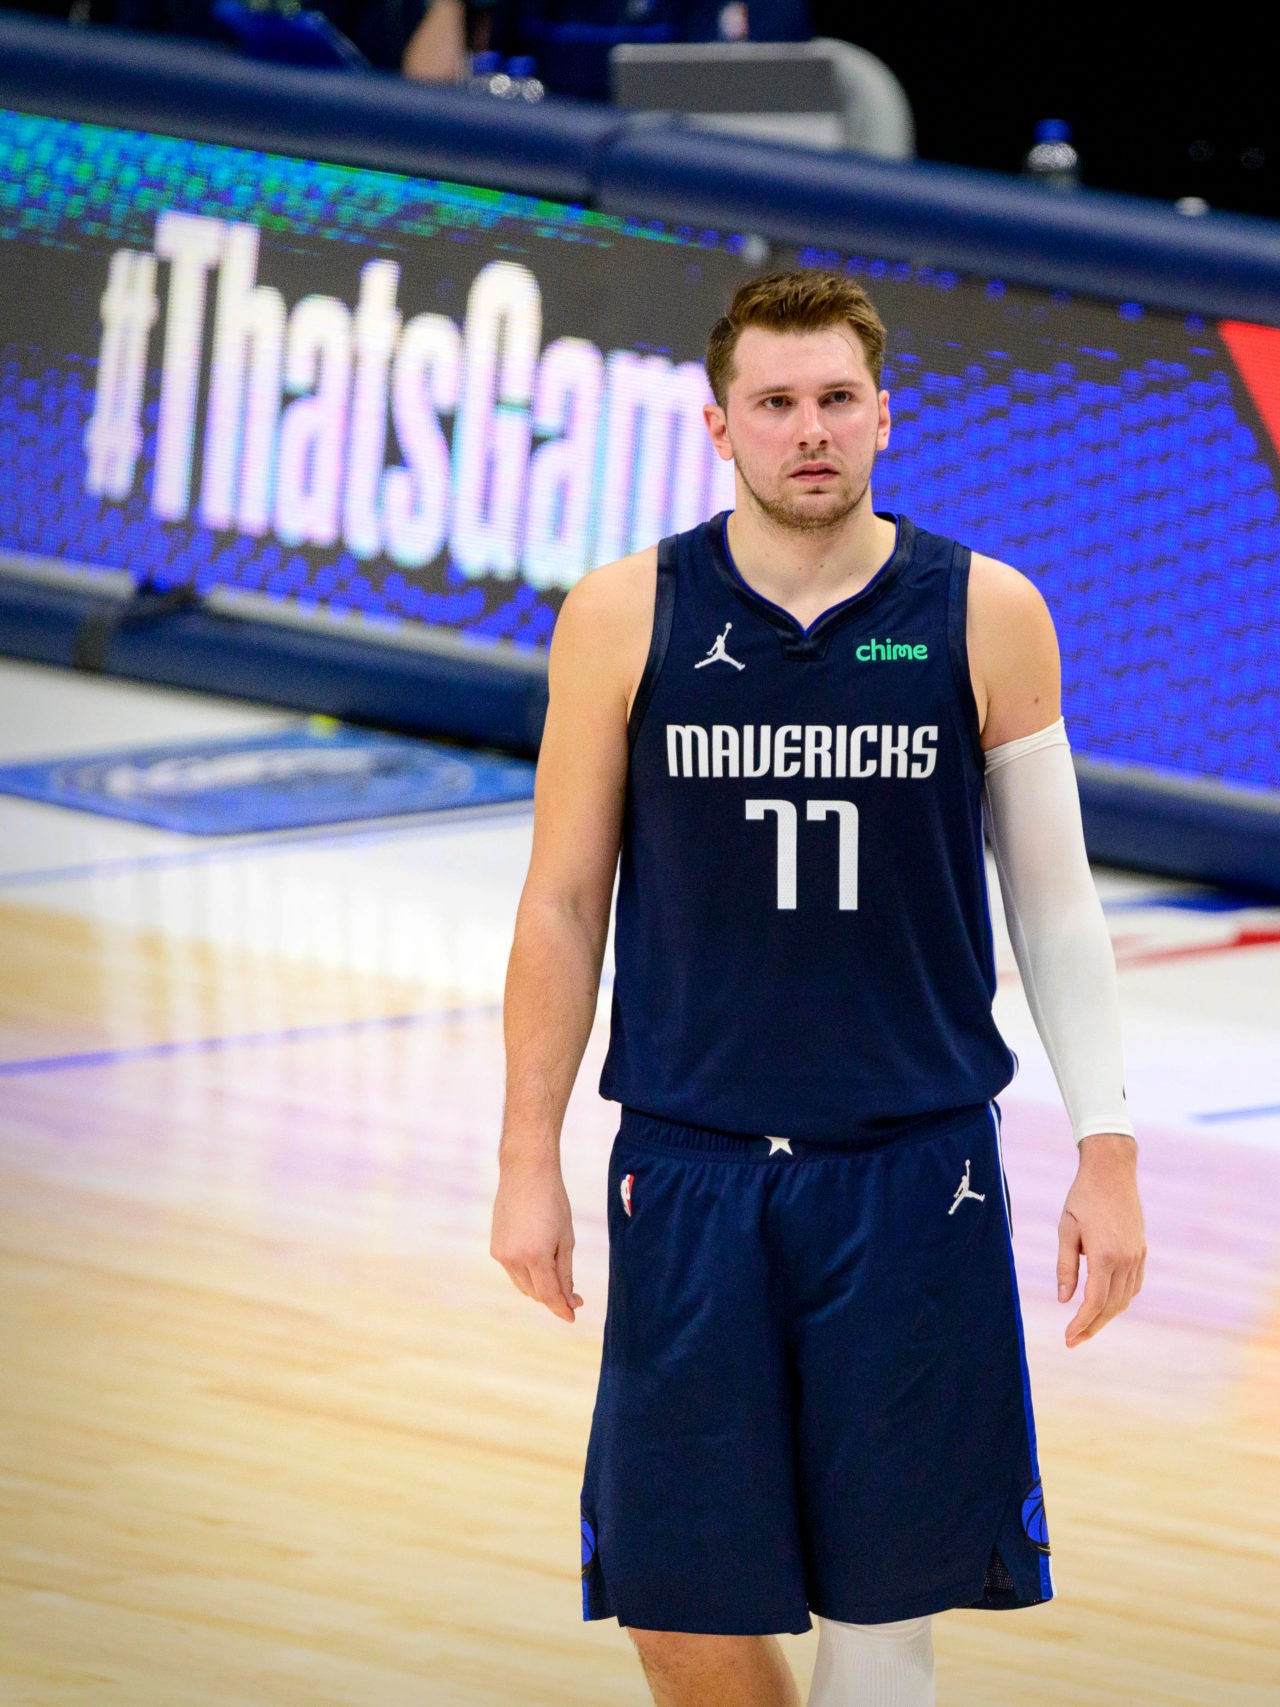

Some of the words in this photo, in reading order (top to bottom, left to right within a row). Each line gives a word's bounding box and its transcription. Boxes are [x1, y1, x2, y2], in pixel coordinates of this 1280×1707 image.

[855, 638, 928, 662] chime
[666, 724, 939, 779] MAVERICKS
[745, 798, 860, 911] 77
